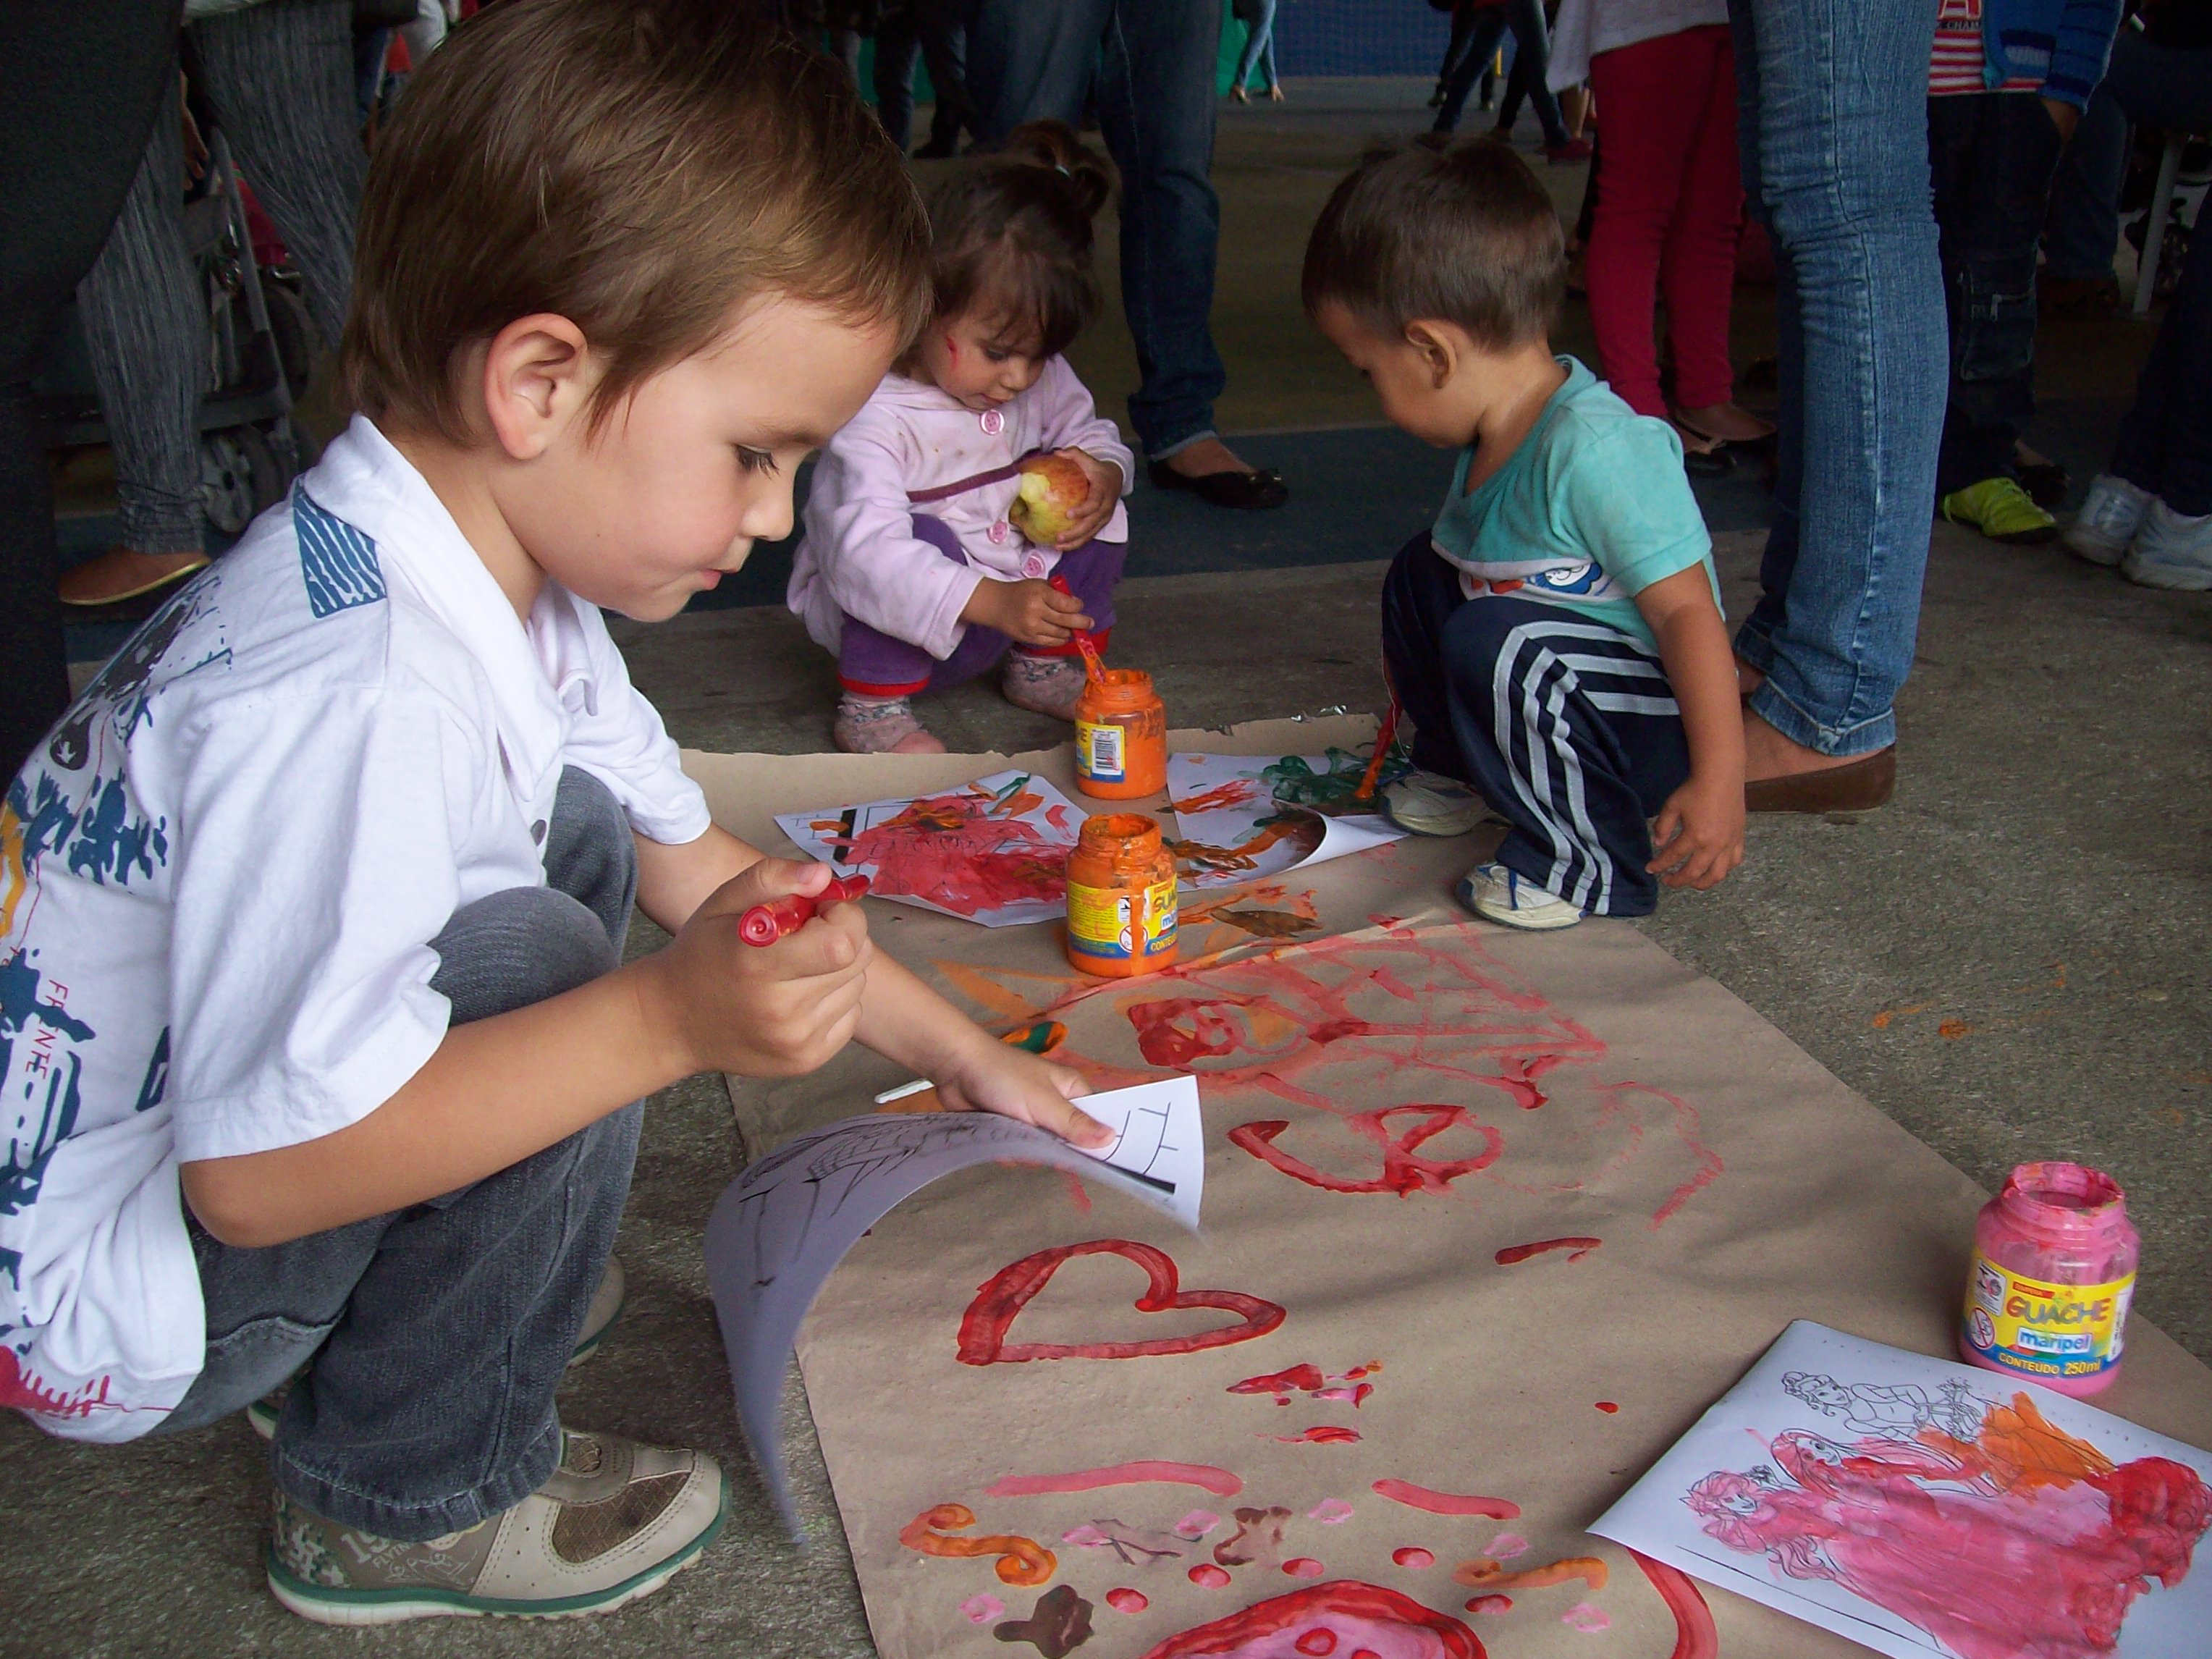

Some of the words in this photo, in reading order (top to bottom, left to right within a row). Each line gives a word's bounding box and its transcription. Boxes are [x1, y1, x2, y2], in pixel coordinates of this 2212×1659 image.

[2006, 1296, 2111, 1325] GUACHE
[2019, 1331, 2090, 1351] maripel
[2064, 1360, 2101, 1375] 250ml
